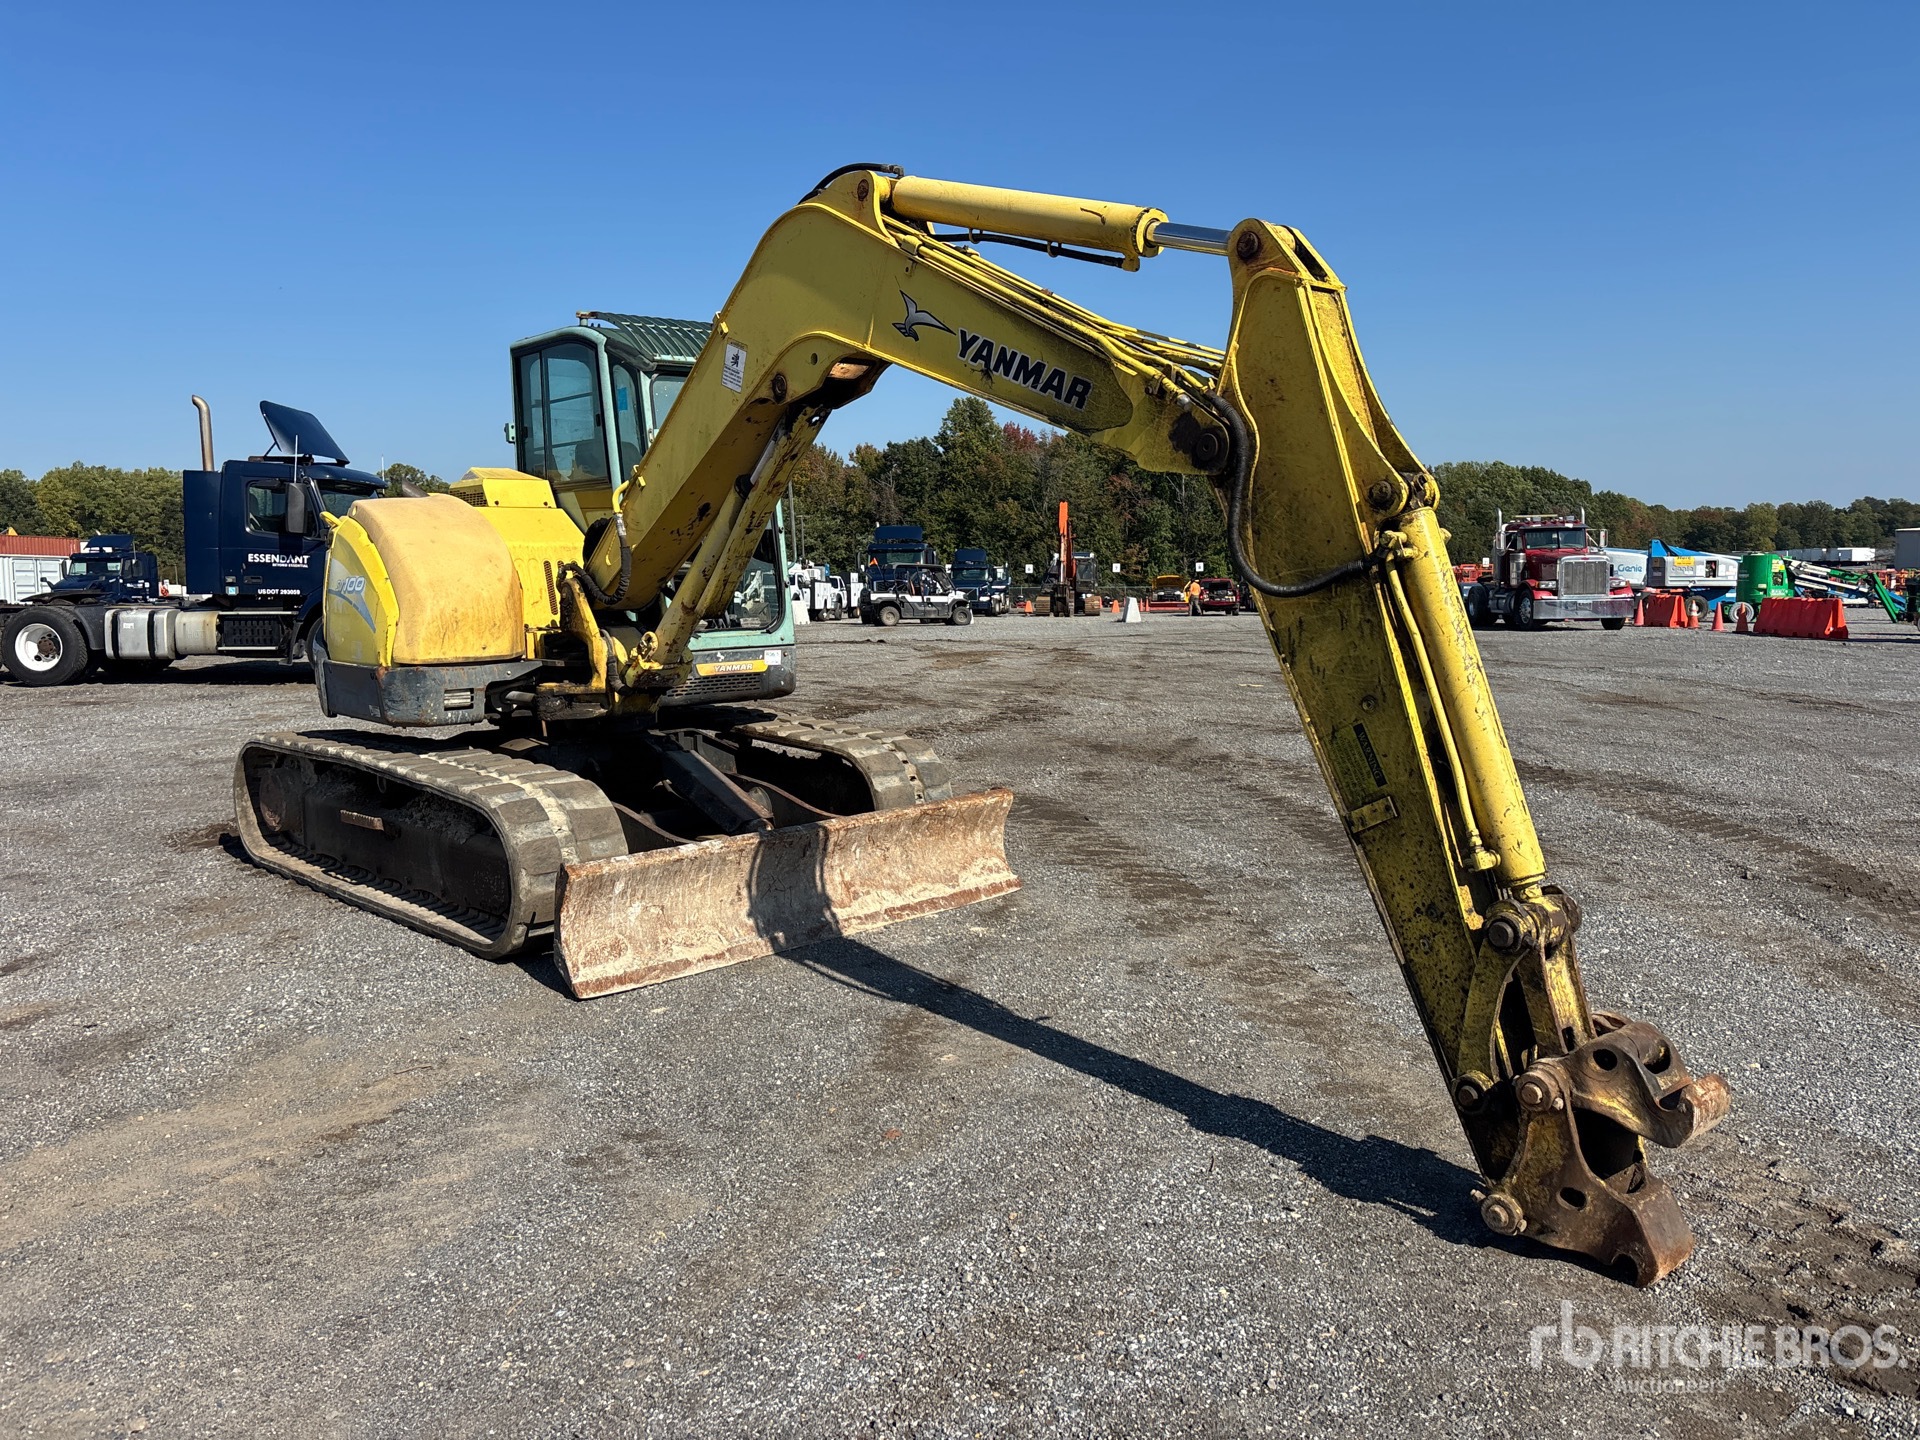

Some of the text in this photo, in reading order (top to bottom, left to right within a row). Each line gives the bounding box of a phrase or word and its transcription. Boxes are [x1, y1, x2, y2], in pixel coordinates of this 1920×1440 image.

[958, 329, 1091, 411] YANMAR
[247, 553, 310, 564] ESSENDANT
[1617, 563, 1643, 573] Genie
[714, 663, 753, 672] YANMAR
[1357, 731, 1382, 780] WARNING
